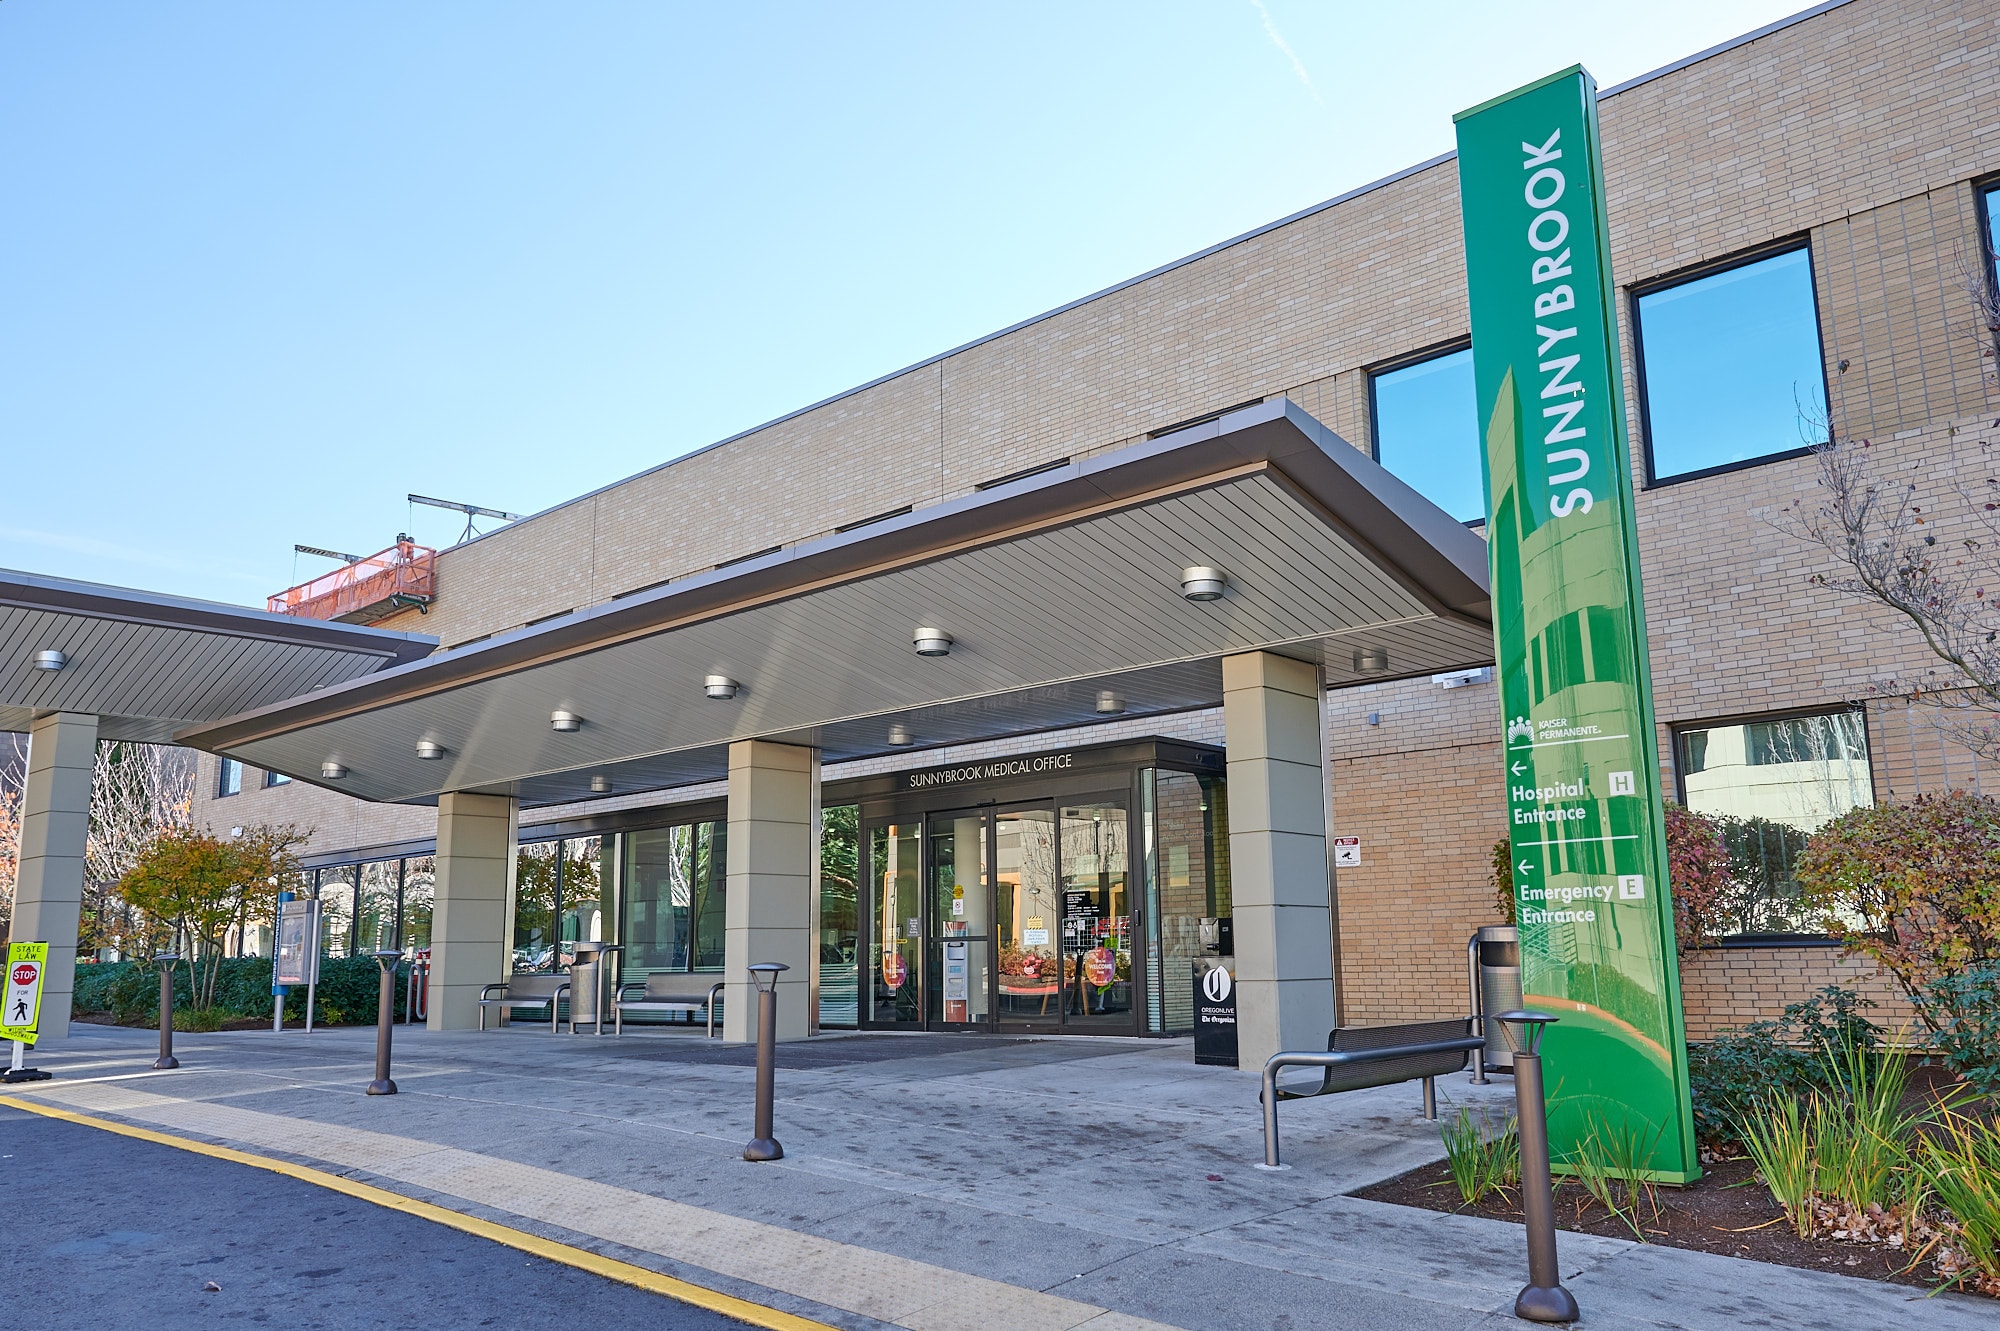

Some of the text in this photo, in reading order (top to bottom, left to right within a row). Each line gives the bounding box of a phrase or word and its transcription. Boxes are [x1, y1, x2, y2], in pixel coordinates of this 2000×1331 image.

[1521, 127, 1593, 518] SUNNYBROOK
[1538, 718, 1567, 729] KAISER
[910, 753, 1072, 788] SUNNYBROOK MEDICAL OFFICE
[1512, 775, 1629, 804] Hospital H
[1514, 806, 1586, 825] Entrance
[1520, 878, 1637, 903] Emergency E
[1522, 908, 1596, 924] Entrance
[14, 970, 36, 979] STOP
[1211, 1015, 1236, 1024] Oregonian
